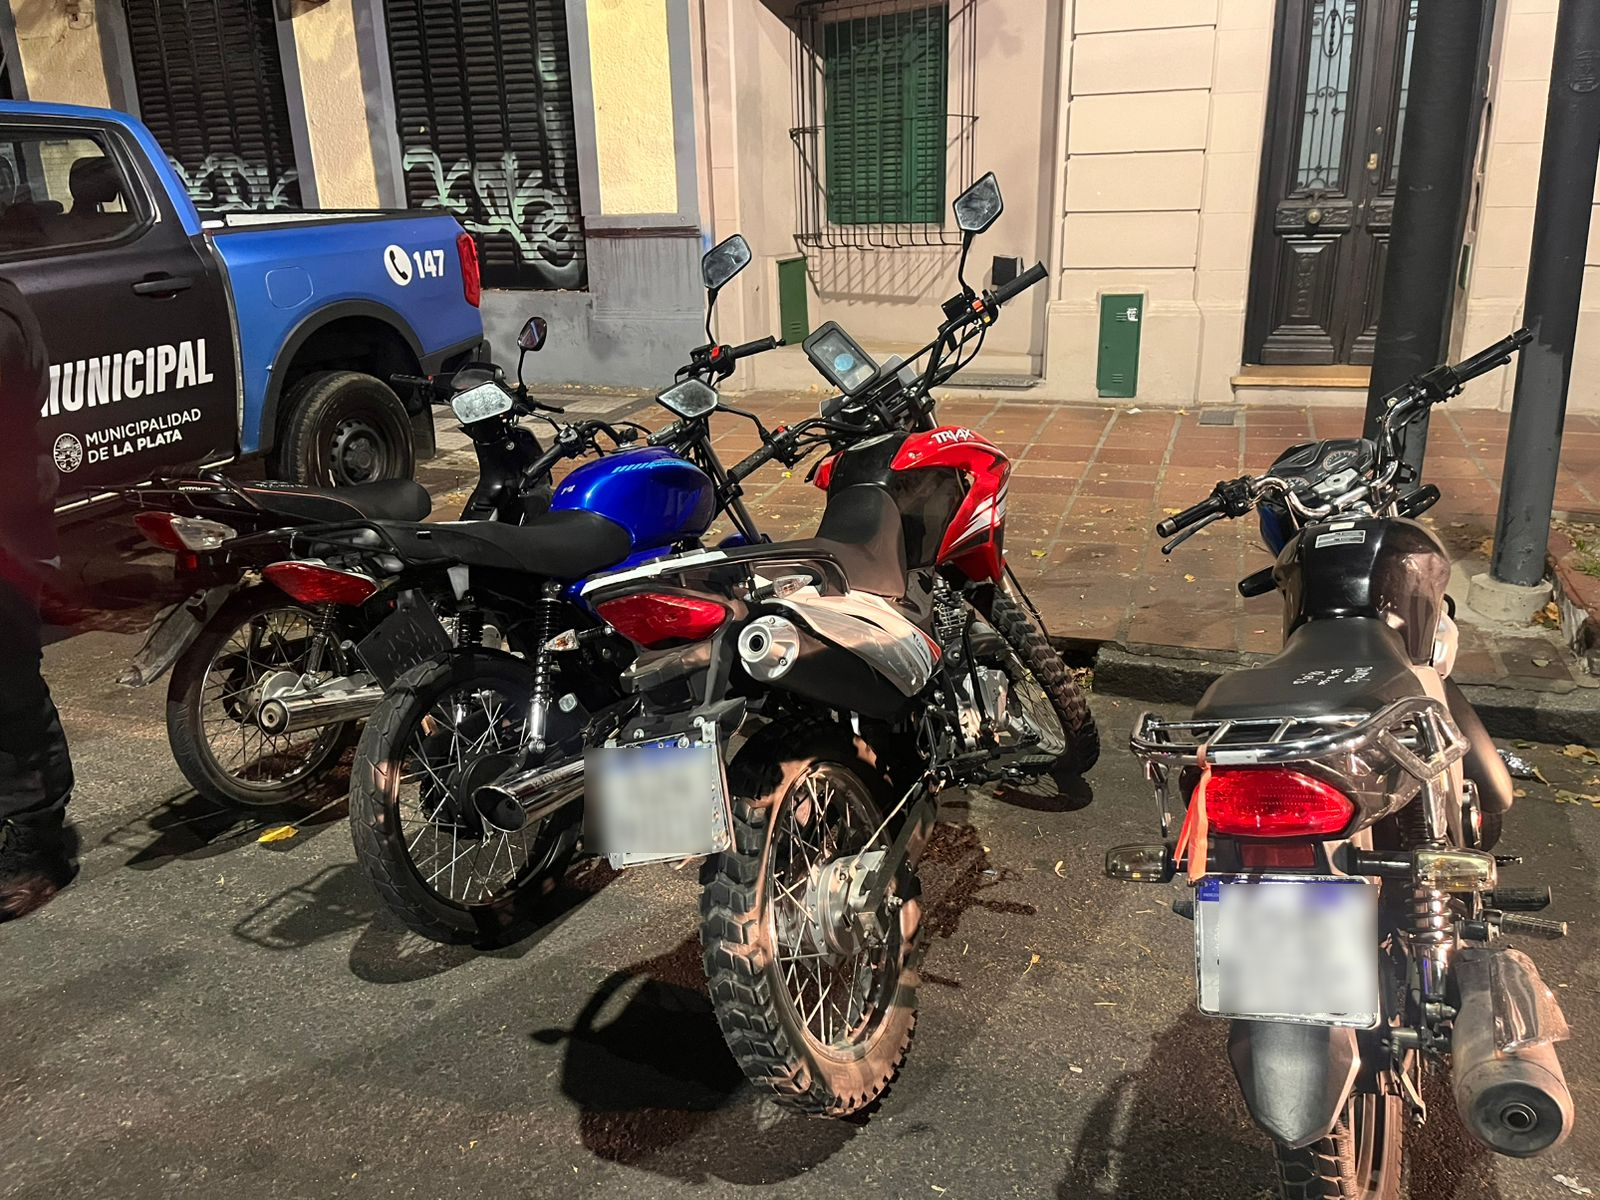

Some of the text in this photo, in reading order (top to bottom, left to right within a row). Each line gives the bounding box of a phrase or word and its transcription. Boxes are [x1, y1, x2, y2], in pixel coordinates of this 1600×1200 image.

[412, 249, 445, 279] 147
[85, 408, 202, 447] MUNICIPALIDAD
[930, 428, 975, 444] TRIAX
[87, 429, 183, 464] DE LA PLATA
